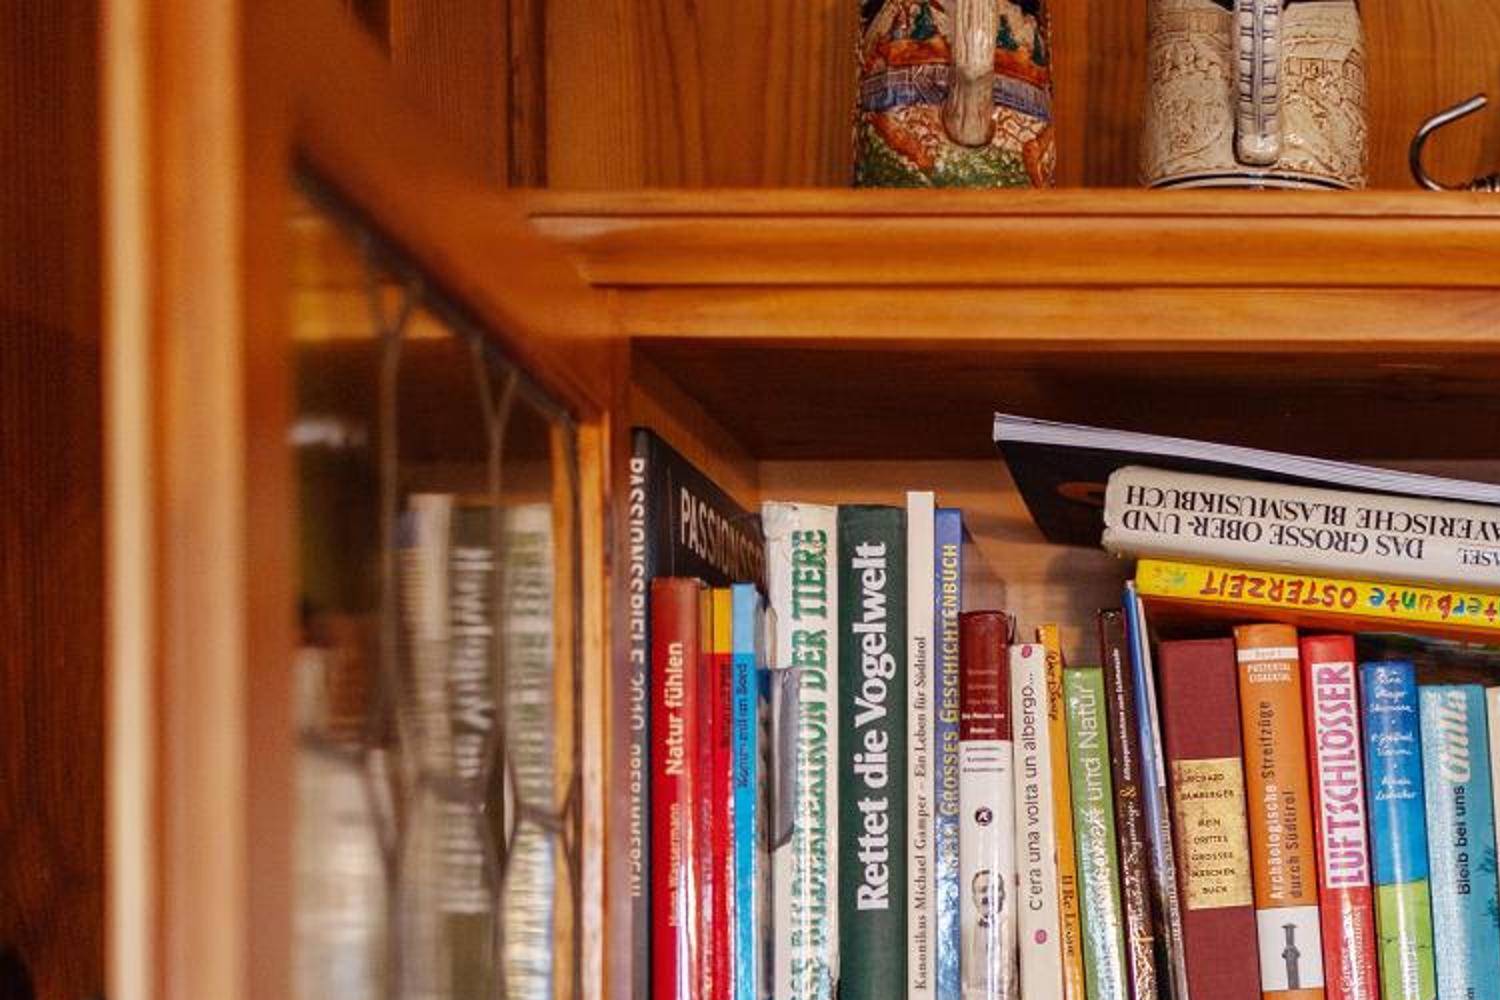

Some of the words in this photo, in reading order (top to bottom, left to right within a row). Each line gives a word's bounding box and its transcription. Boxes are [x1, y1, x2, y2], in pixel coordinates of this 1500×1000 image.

[1121, 508, 1181, 536] UND
[1124, 484, 1347, 527] BLASMUSIKBUCH
[1186, 514, 1263, 544] OBER-
[1269, 522, 1369, 556] GROSSE
[1376, 534, 1424, 560] DAS
[791, 528, 828, 622] TIERE
[1199, 568, 1358, 609] OSTERZEIT
[852, 541, 897, 728] Vogelwelt
[938, 543, 960, 725] GESCHICHTENBUCH
[664, 643, 685, 708] fühlen
[790, 629, 828, 694] DER
[911, 636, 928, 688] Südtirol
[912, 691, 928, 711] für
[1017, 672, 1039, 753] albergo...
[1074, 686, 1099, 750] Natur
[665, 713, 684, 776] Natur
[913, 713, 928, 754] Leben
[1257, 699, 1278, 781] Streifzüge
[854, 729, 889, 788] die
[913, 754, 928, 779] Ein
[938, 730, 960, 818] GROSSES
[1023, 755, 1038, 780] un
[1082, 756, 1105, 801] und
[1316, 664, 1366, 886] LUFTSCHLÖSSER
[913, 795, 931, 850] Gamper
[1021, 783, 1039, 828] volta
[1281, 789, 1301, 852] Südtirol
[1452, 784, 1466, 817] uns
[857, 796, 891, 911] Rettet
[1024, 830, 1041, 863] una
[1261, 783, 1286, 901] Archäologische
[1452, 821, 1468, 848] bei
[913, 854, 928, 911] Michael
[1026, 867, 1044, 912] C'era
[1284, 855, 1304, 900] durch
[1455, 852, 1472, 896] Bleib
[1062, 889, 1075, 911] Re
[913, 914, 928, 992] Kanonikus
[1063, 913, 1077, 957] Leone
